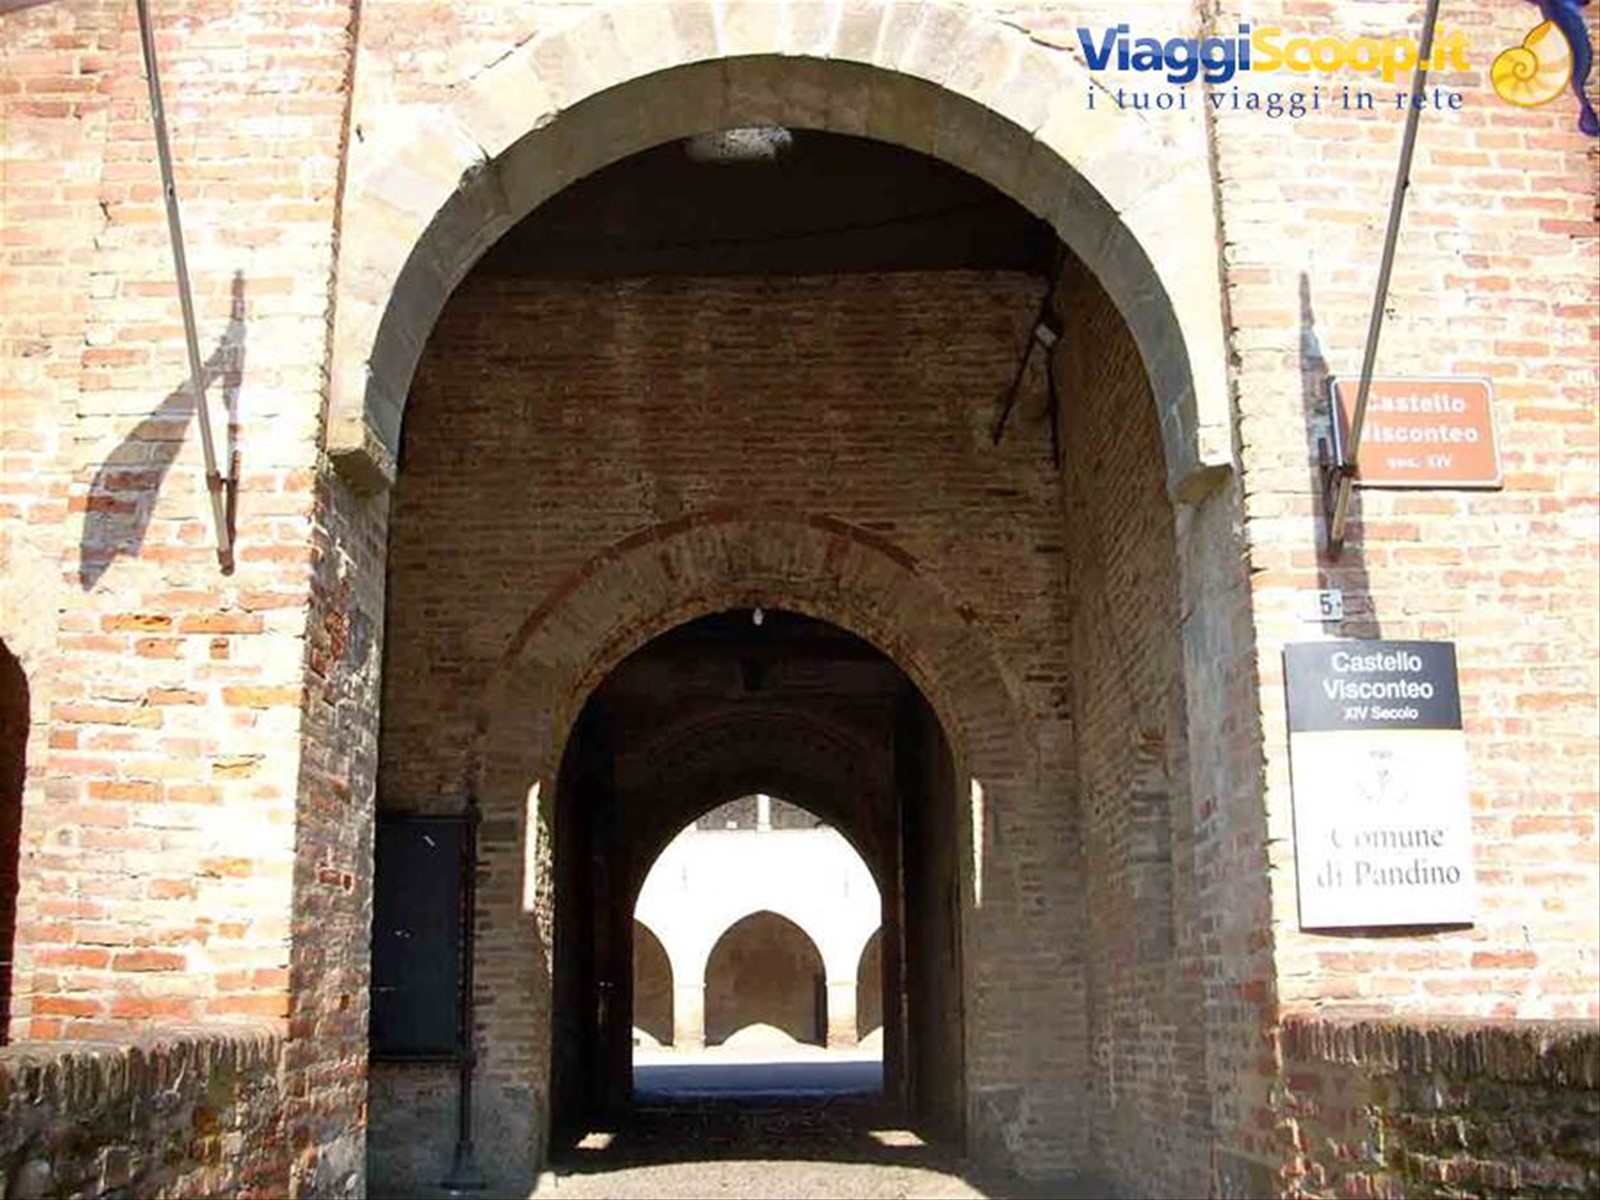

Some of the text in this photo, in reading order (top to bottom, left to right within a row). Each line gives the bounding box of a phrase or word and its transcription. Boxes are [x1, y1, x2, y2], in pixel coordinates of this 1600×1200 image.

[1360, 423, 1478, 444] isconteo
[1331, 651, 1423, 672] Castello
[1322, 679, 1434, 699] Visconteo
[1344, 706, 1419, 721] XIV Secolo
[1331, 828, 1444, 848] Comune
[1317, 857, 1461, 888] di Pandino
